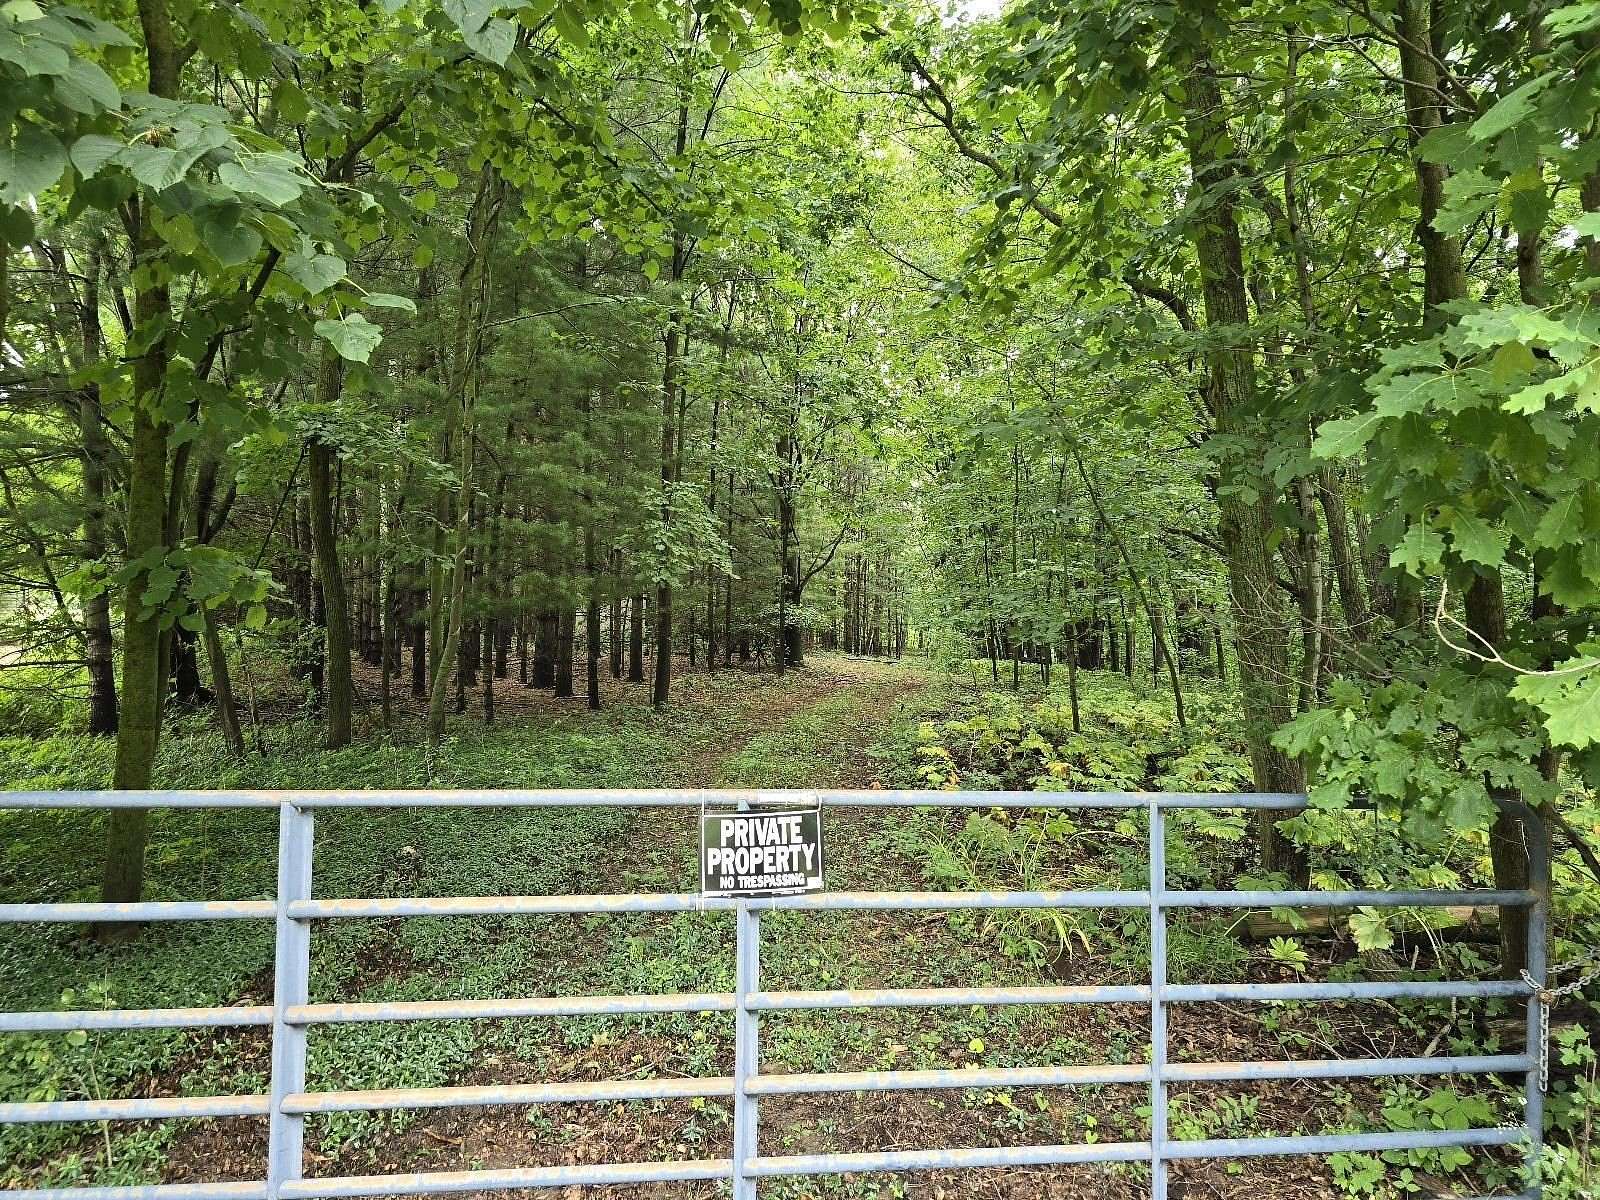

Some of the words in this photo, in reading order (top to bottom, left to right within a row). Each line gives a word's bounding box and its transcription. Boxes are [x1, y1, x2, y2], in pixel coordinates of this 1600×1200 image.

[720, 815, 803, 847] PRIVATE
[707, 843, 816, 875] PROPERTY
[720, 875, 735, 889] NO
[737, 873, 805, 889] TRESPASSING
